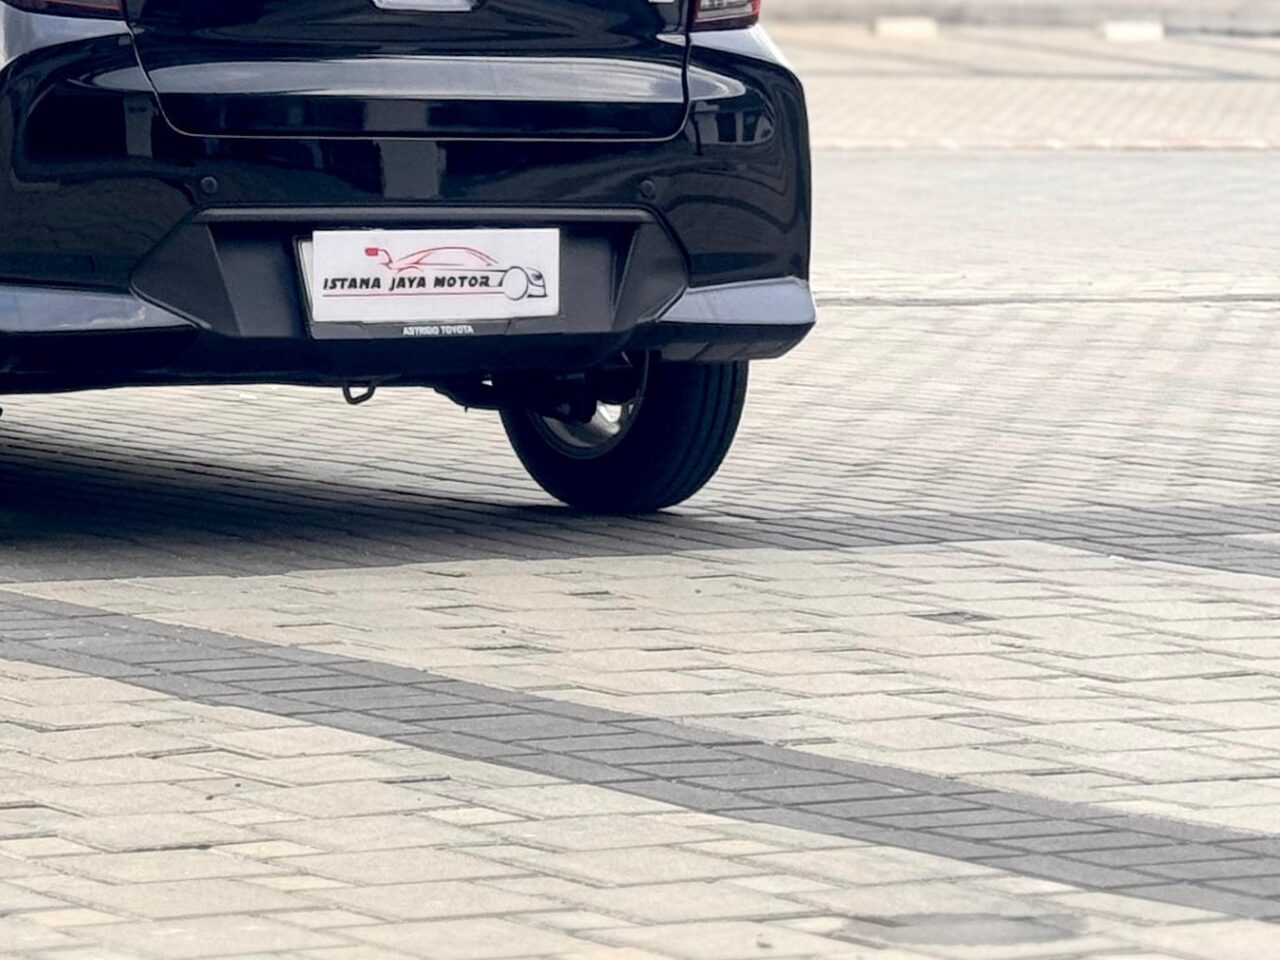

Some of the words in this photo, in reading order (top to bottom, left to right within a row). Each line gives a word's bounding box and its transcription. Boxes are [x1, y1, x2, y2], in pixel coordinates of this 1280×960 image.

[323, 277, 382, 291] ISTANA
[388, 276, 427, 291] JAYA
[433, 275, 491, 289] MOTOR
[440, 324, 474, 335] TOYOTA
